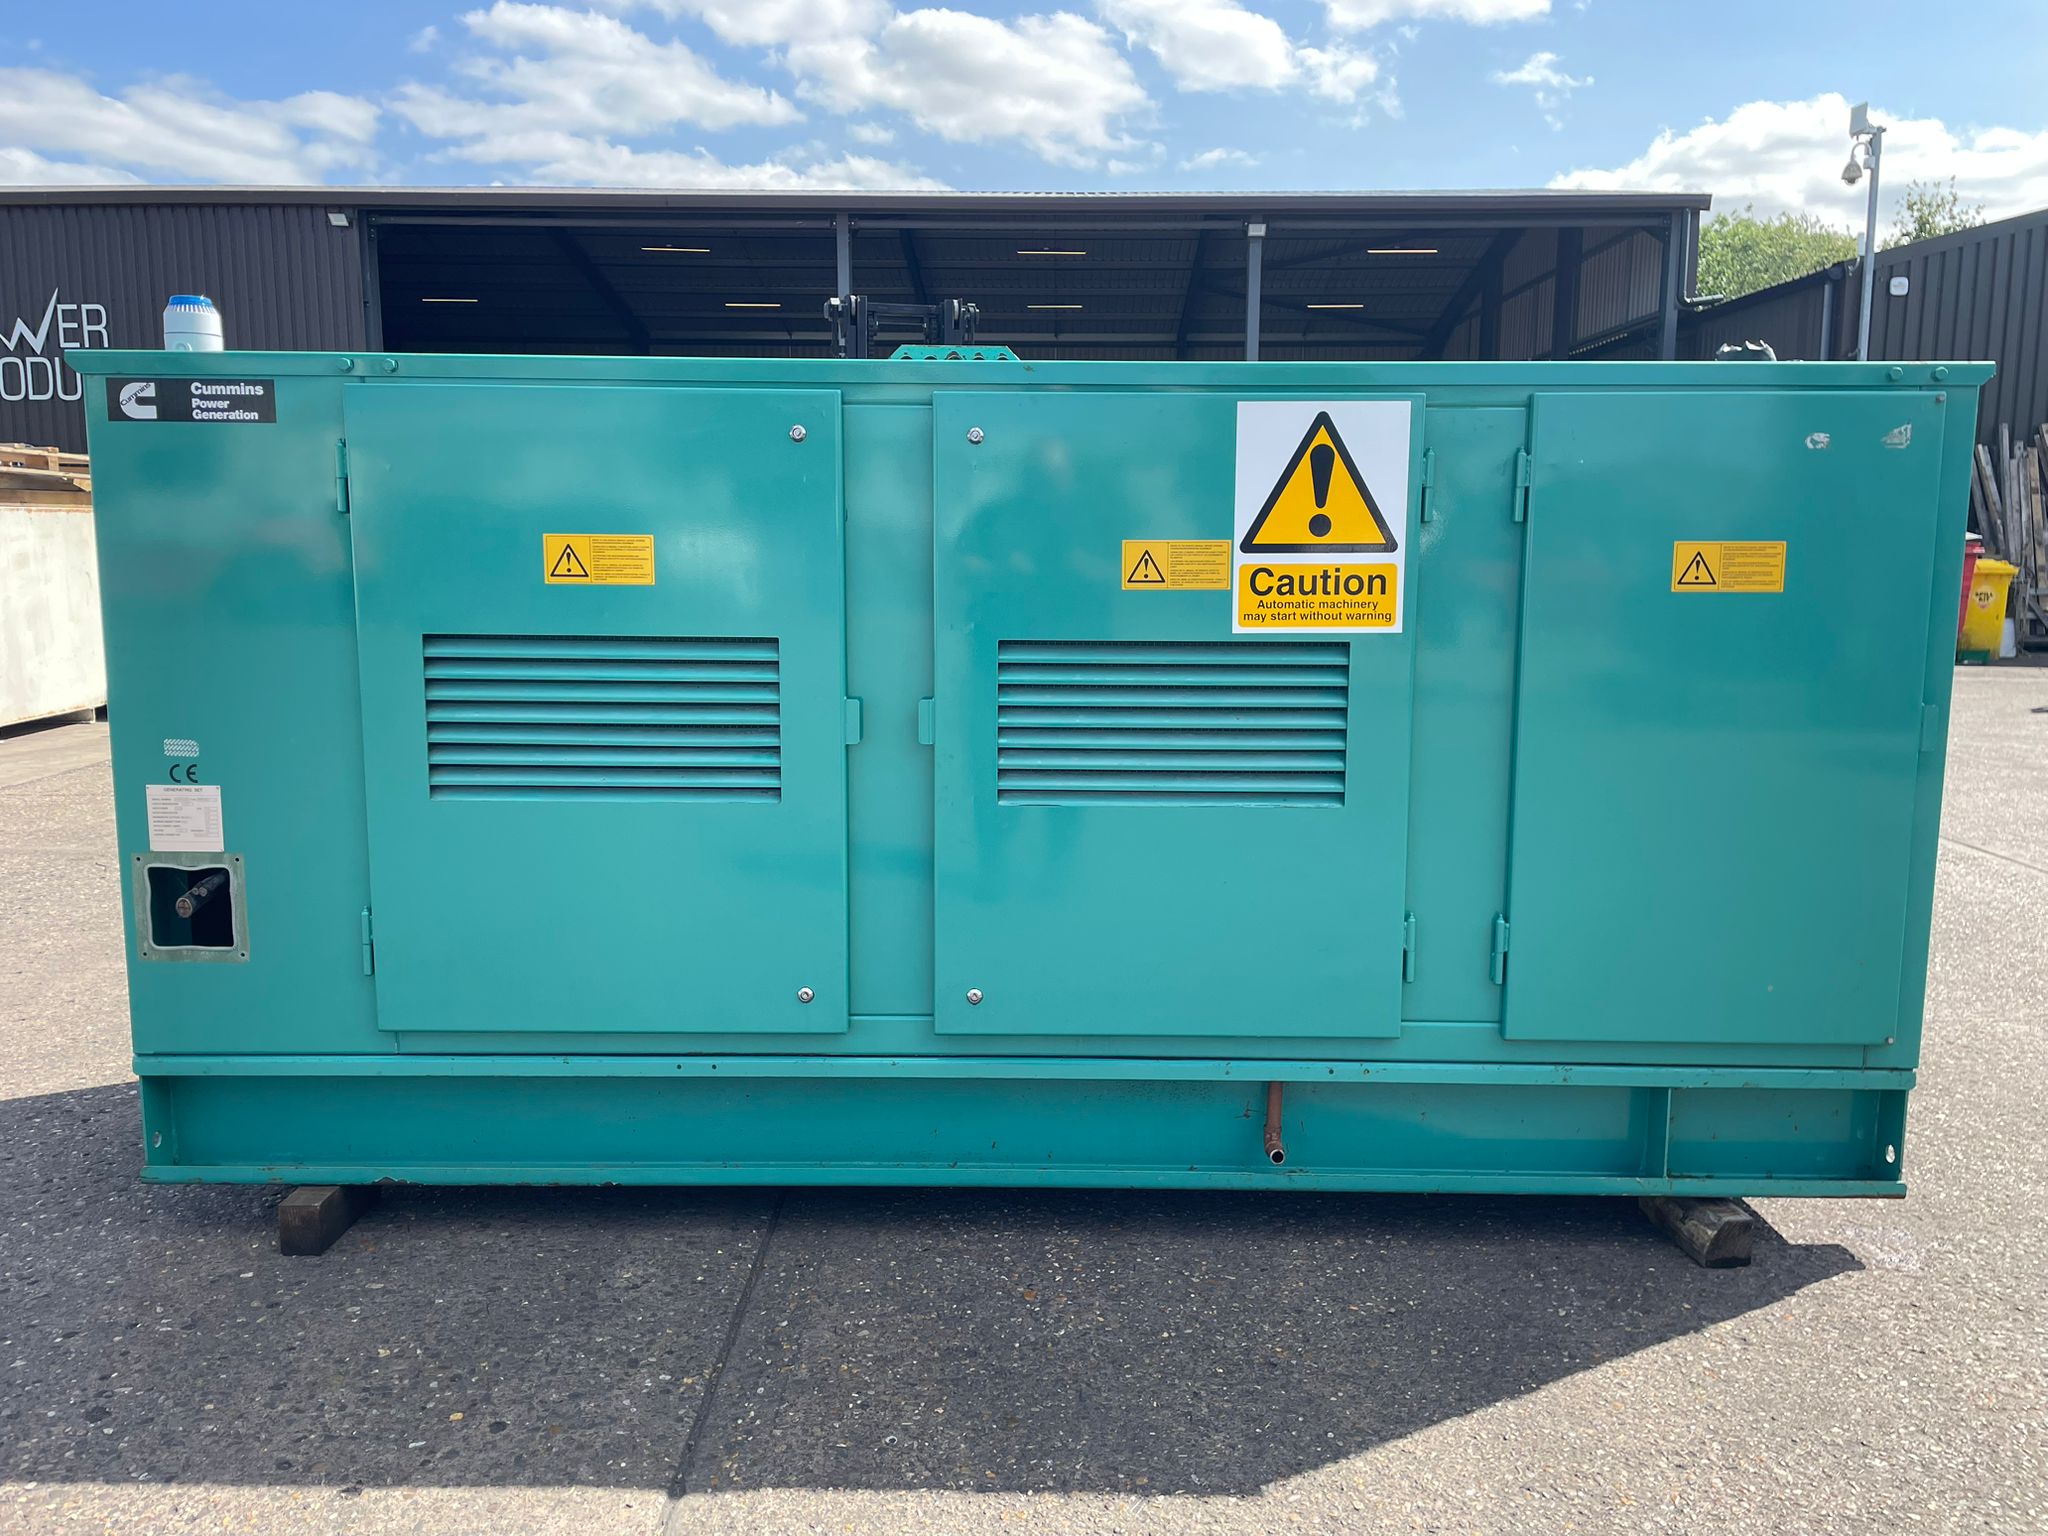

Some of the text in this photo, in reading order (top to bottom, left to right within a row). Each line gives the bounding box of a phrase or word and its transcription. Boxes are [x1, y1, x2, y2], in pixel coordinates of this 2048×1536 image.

[120, 382, 152, 406] Cummins
[190, 382, 264, 396] Cummins
[191, 398, 230, 409] Power
[192, 409, 259, 420] Generation
[1249, 567, 1387, 597] Caution
[1257, 599, 1379, 611] Automatic machinery
[1243, 611, 1392, 623] may start without warning
[169, 763, 199, 784] CE
